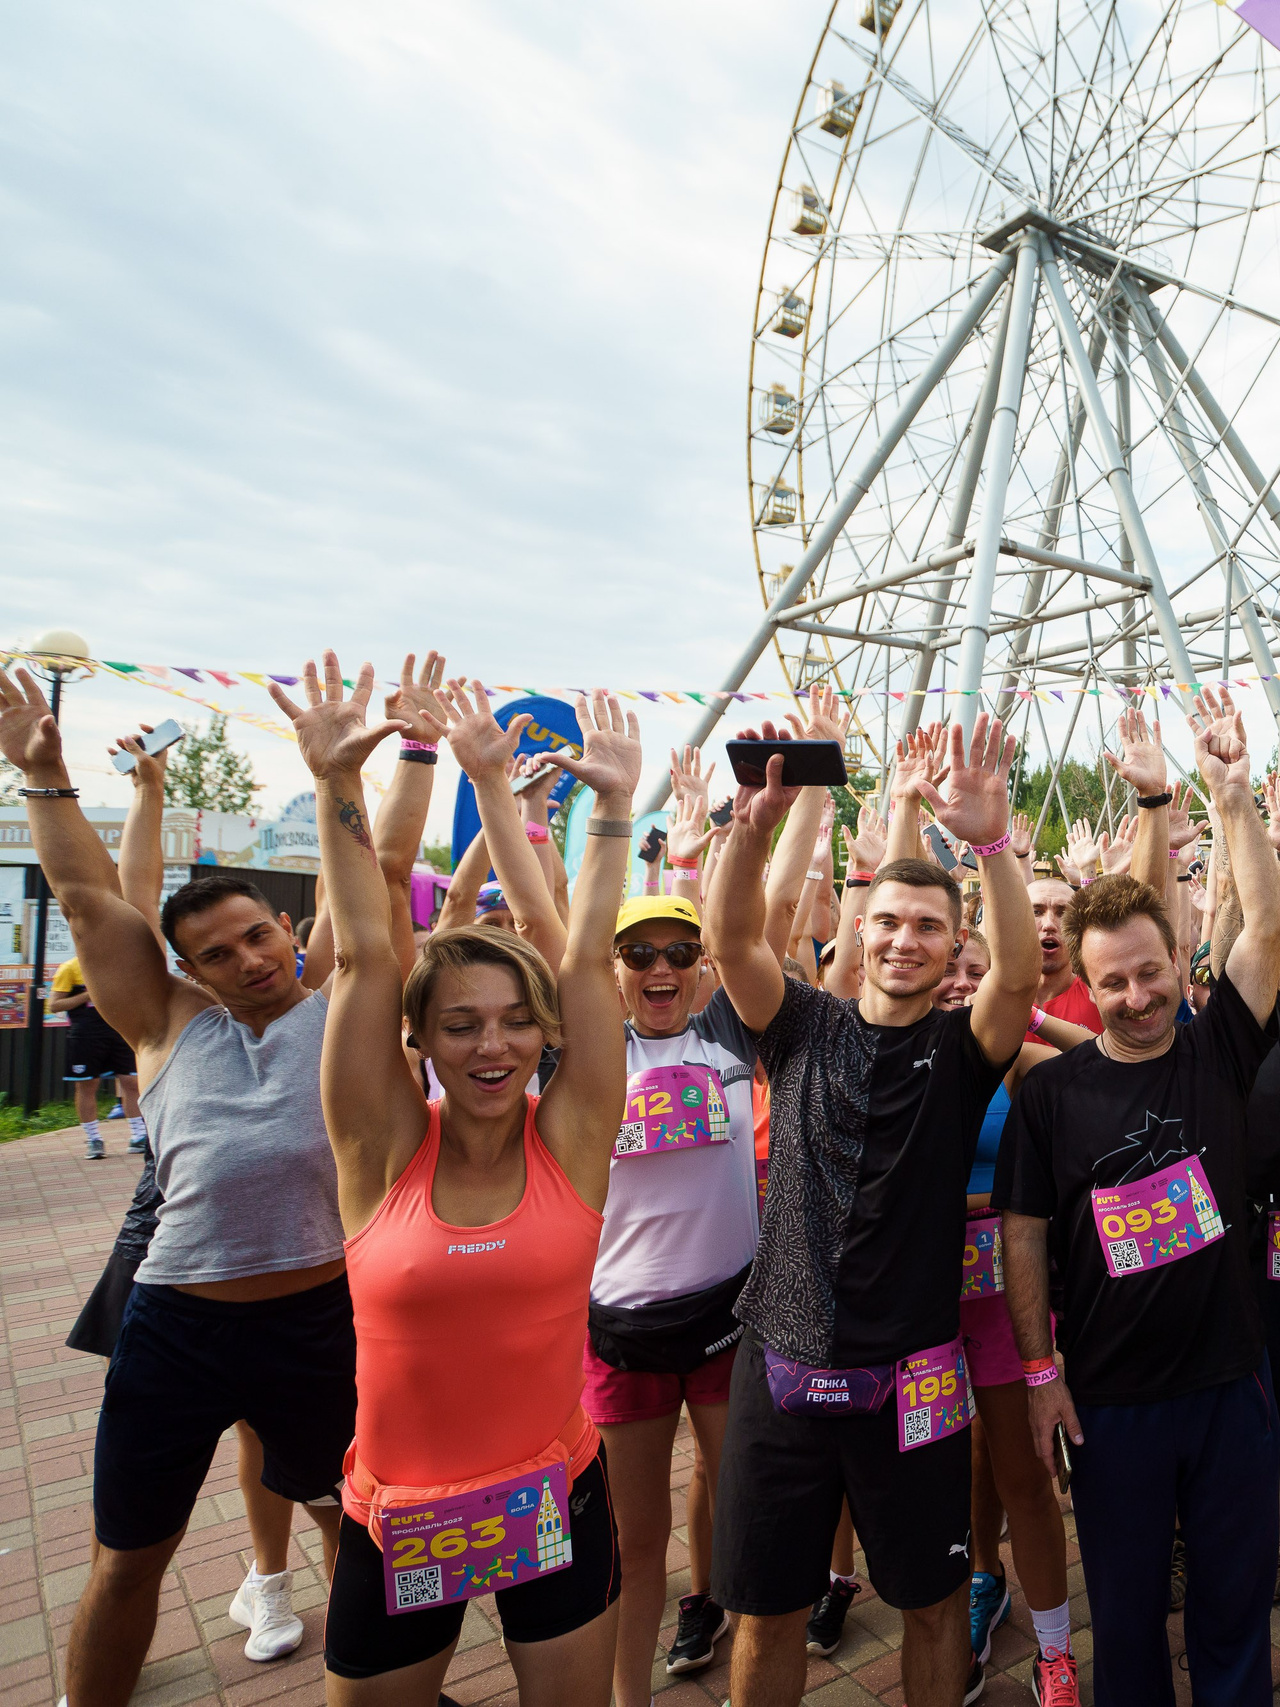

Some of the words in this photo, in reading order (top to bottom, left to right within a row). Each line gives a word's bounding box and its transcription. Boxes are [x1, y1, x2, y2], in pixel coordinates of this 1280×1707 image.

[687, 1089, 697, 1099] 2
[1172, 1183, 1181, 1193] 1
[1096, 1194, 1121, 1205] RUTS
[1102, 1197, 1178, 1239] 093
[982, 1234, 988, 1243] 1
[447, 1239, 506, 1255] FREDDY
[905, 1358, 928, 1370] UTS
[811, 1378, 848, 1389] ГОНКА
[903, 1368, 957, 1407] 195
[806, 1391, 850, 1402] ГЕРОЕВ
[518, 1492, 527, 1505] 1
[511, 1503, 535, 1513] ВОЛНА
[390, 1511, 435, 1526] RUTS
[392, 1522, 443, 1535] ЯРОСЛАВЛЬ
[443, 1516, 463, 1526] 2023
[392, 1515, 506, 1568] 263
